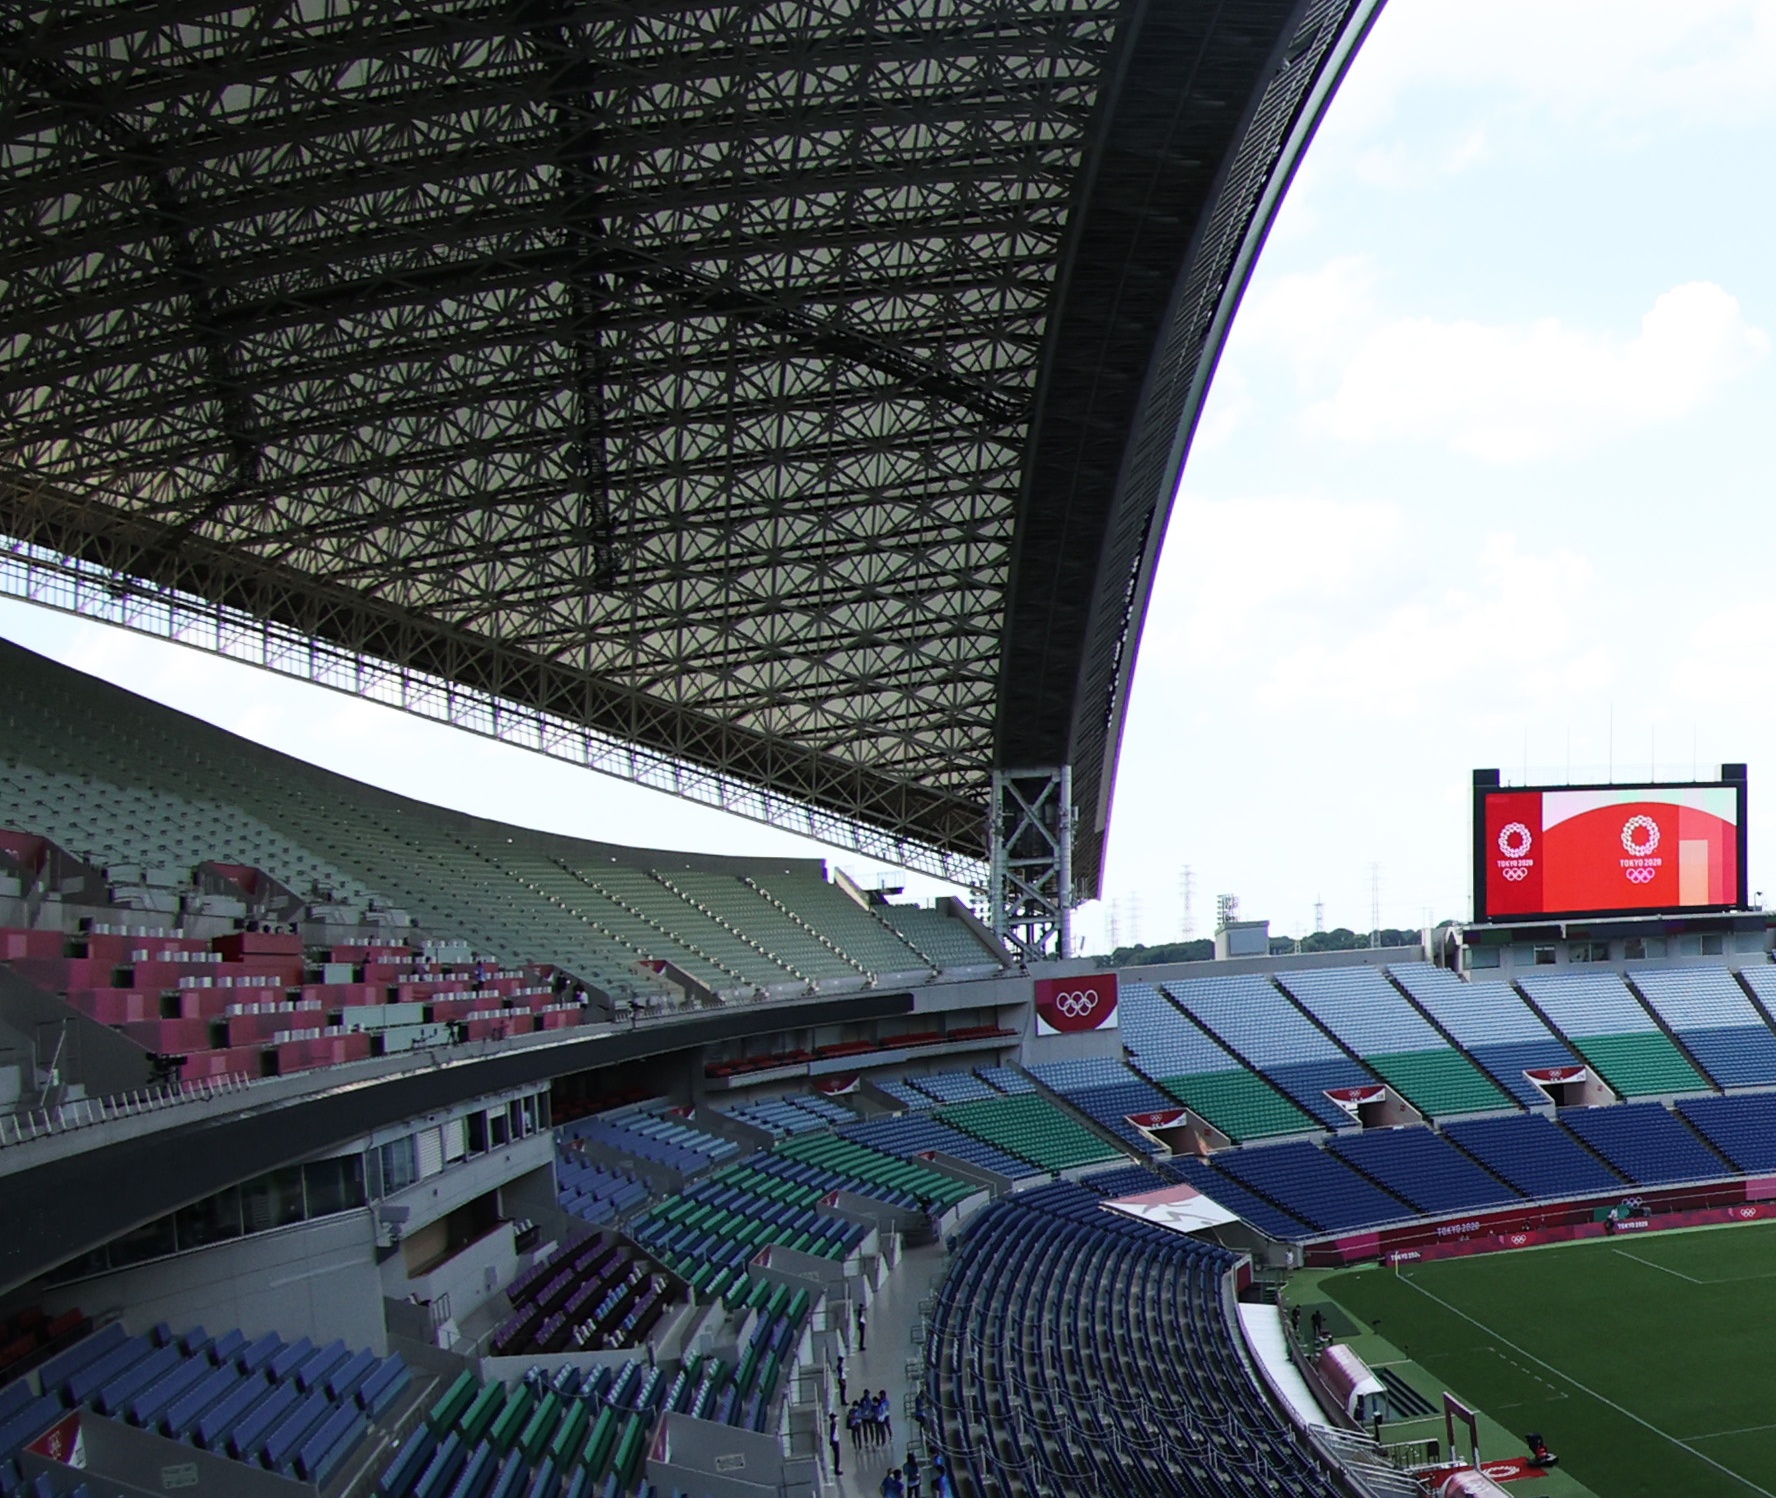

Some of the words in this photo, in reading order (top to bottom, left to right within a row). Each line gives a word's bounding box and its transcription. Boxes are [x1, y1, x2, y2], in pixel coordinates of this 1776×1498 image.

[1497, 859, 1517, 868] TOKYO
[1518, 859, 1534, 867] 2020
[1620, 858, 1643, 868] TOKYO
[1644, 858, 1662, 867] 2020
